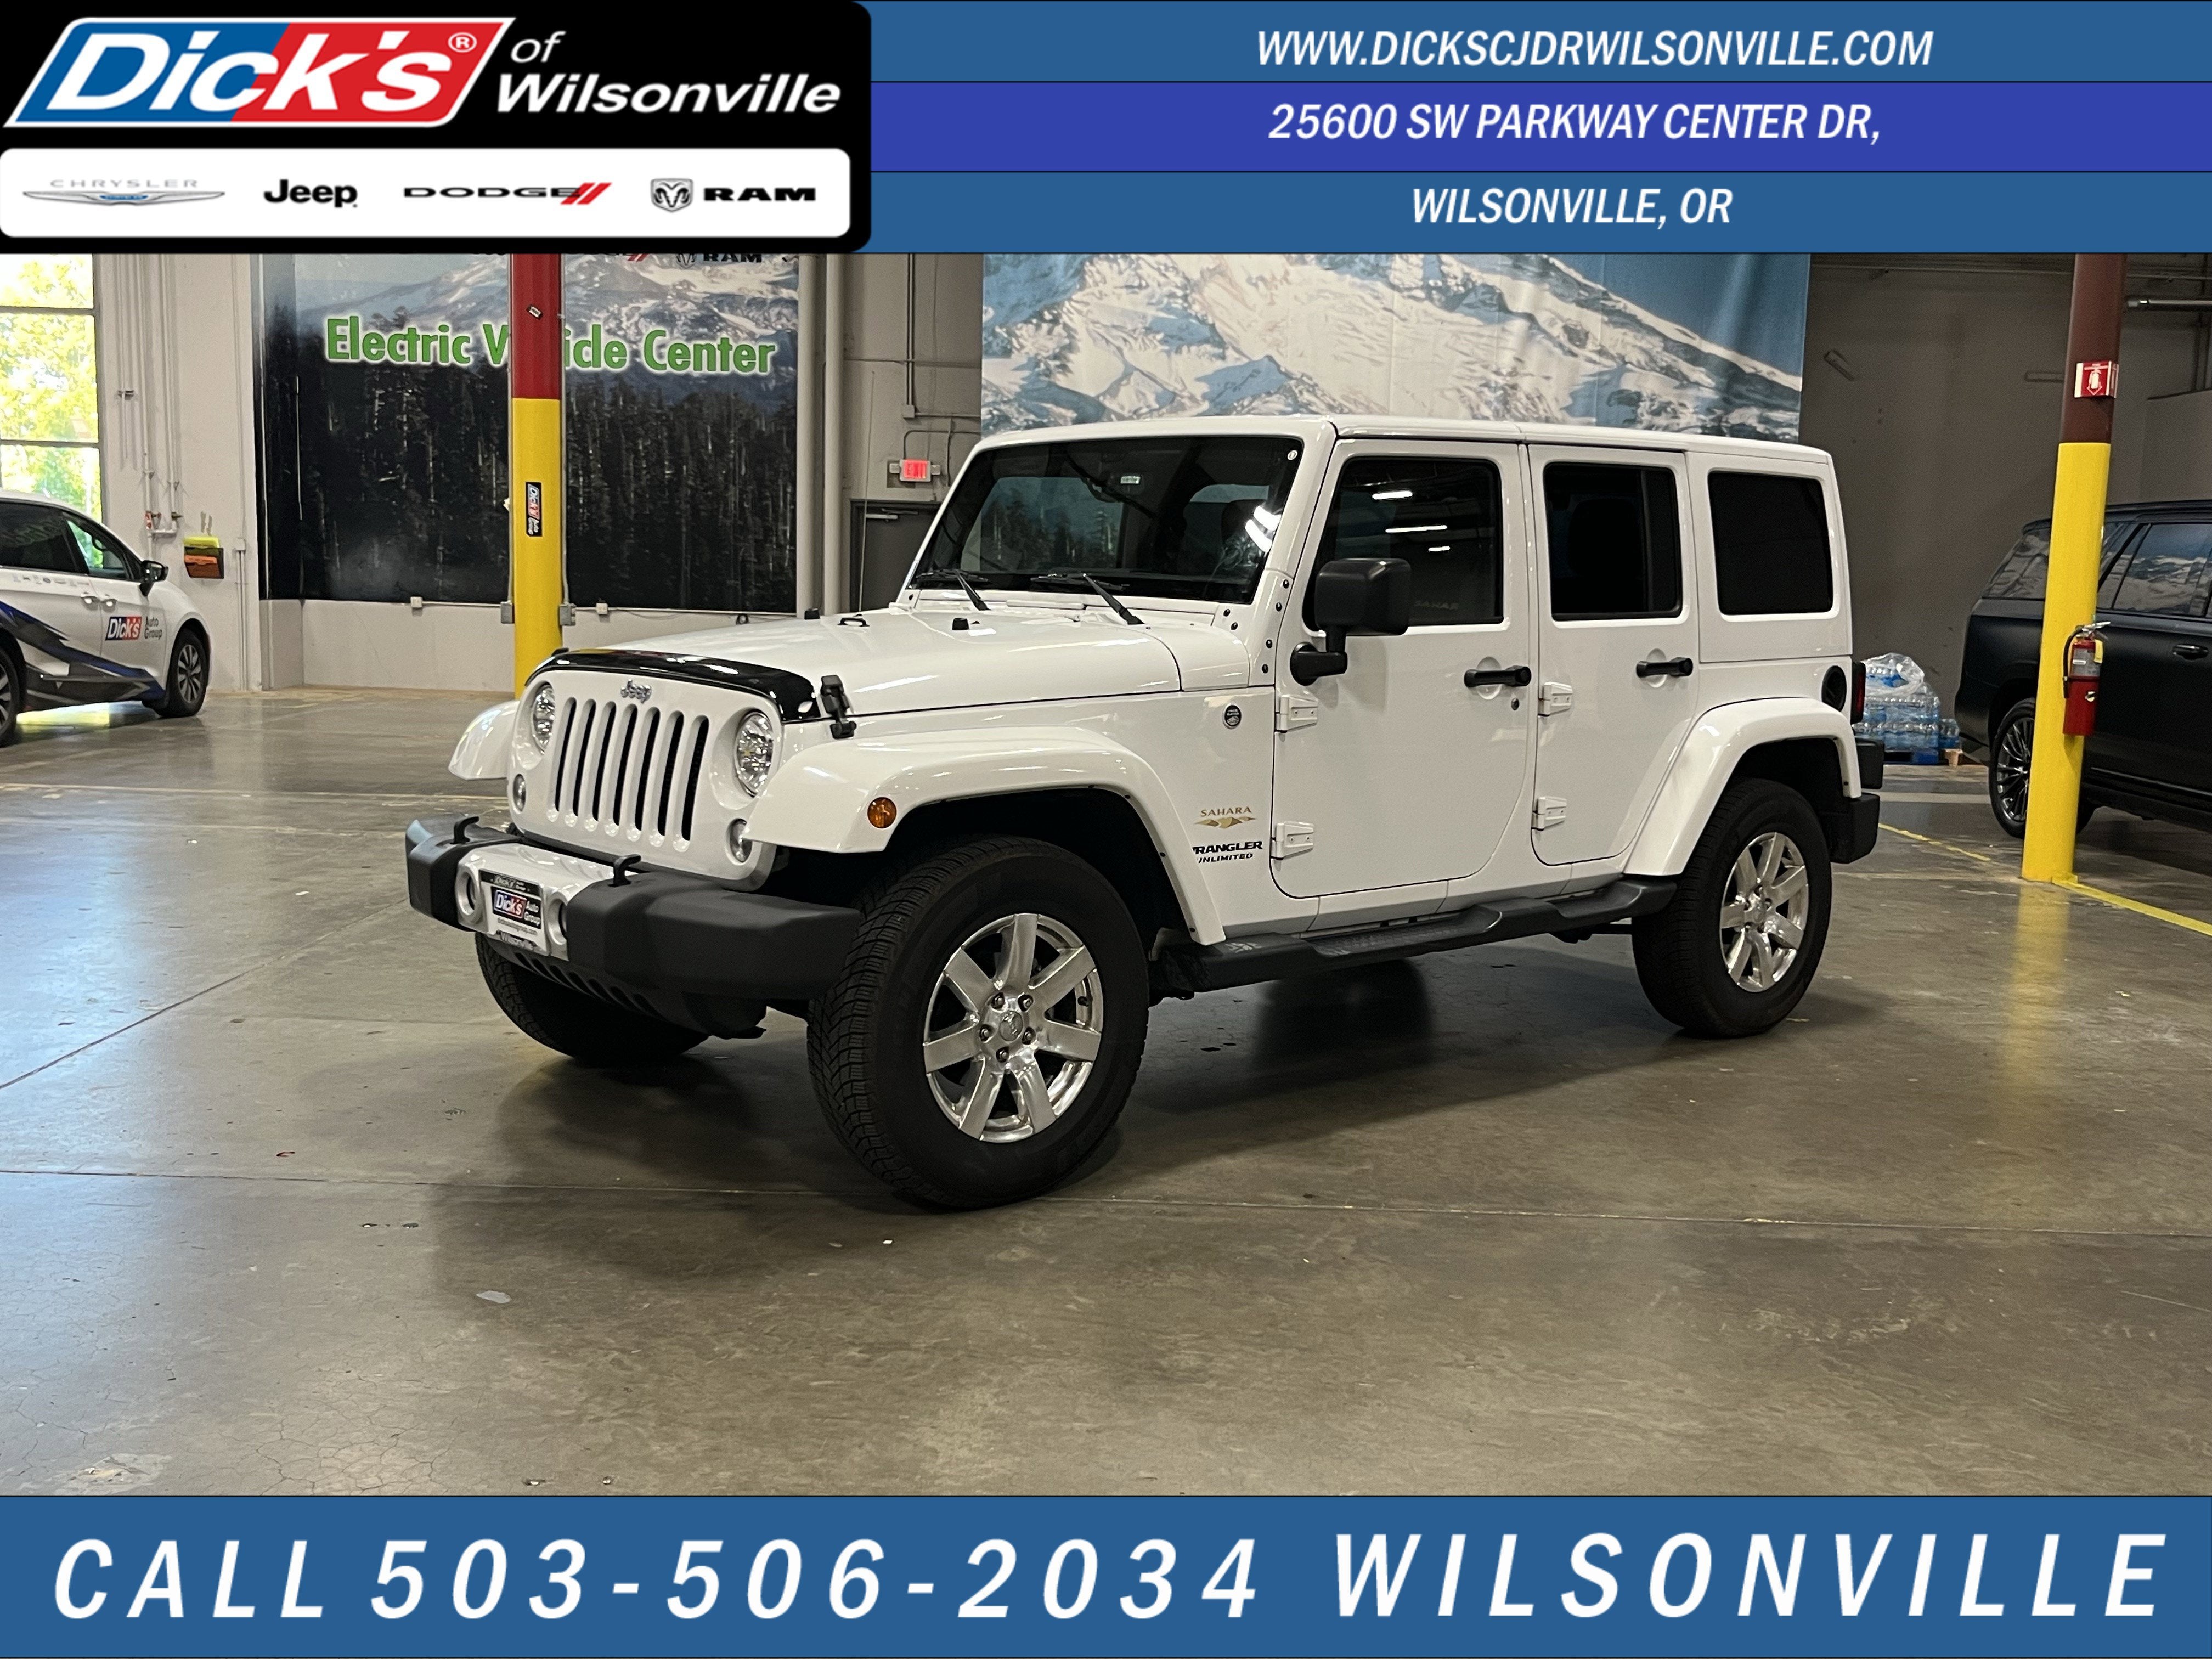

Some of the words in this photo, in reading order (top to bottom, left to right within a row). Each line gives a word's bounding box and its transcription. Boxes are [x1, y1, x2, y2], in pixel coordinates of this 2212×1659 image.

[328, 316, 471, 364] Electric
[644, 329, 775, 373] Center
[108, 618, 140, 639] Dick's
[620, 679, 652, 704] Jeep
[1200, 806, 1252, 817] SAHARA
[1192, 841, 1263, 854] RANGLER
[495, 893, 523, 915] Dick's
